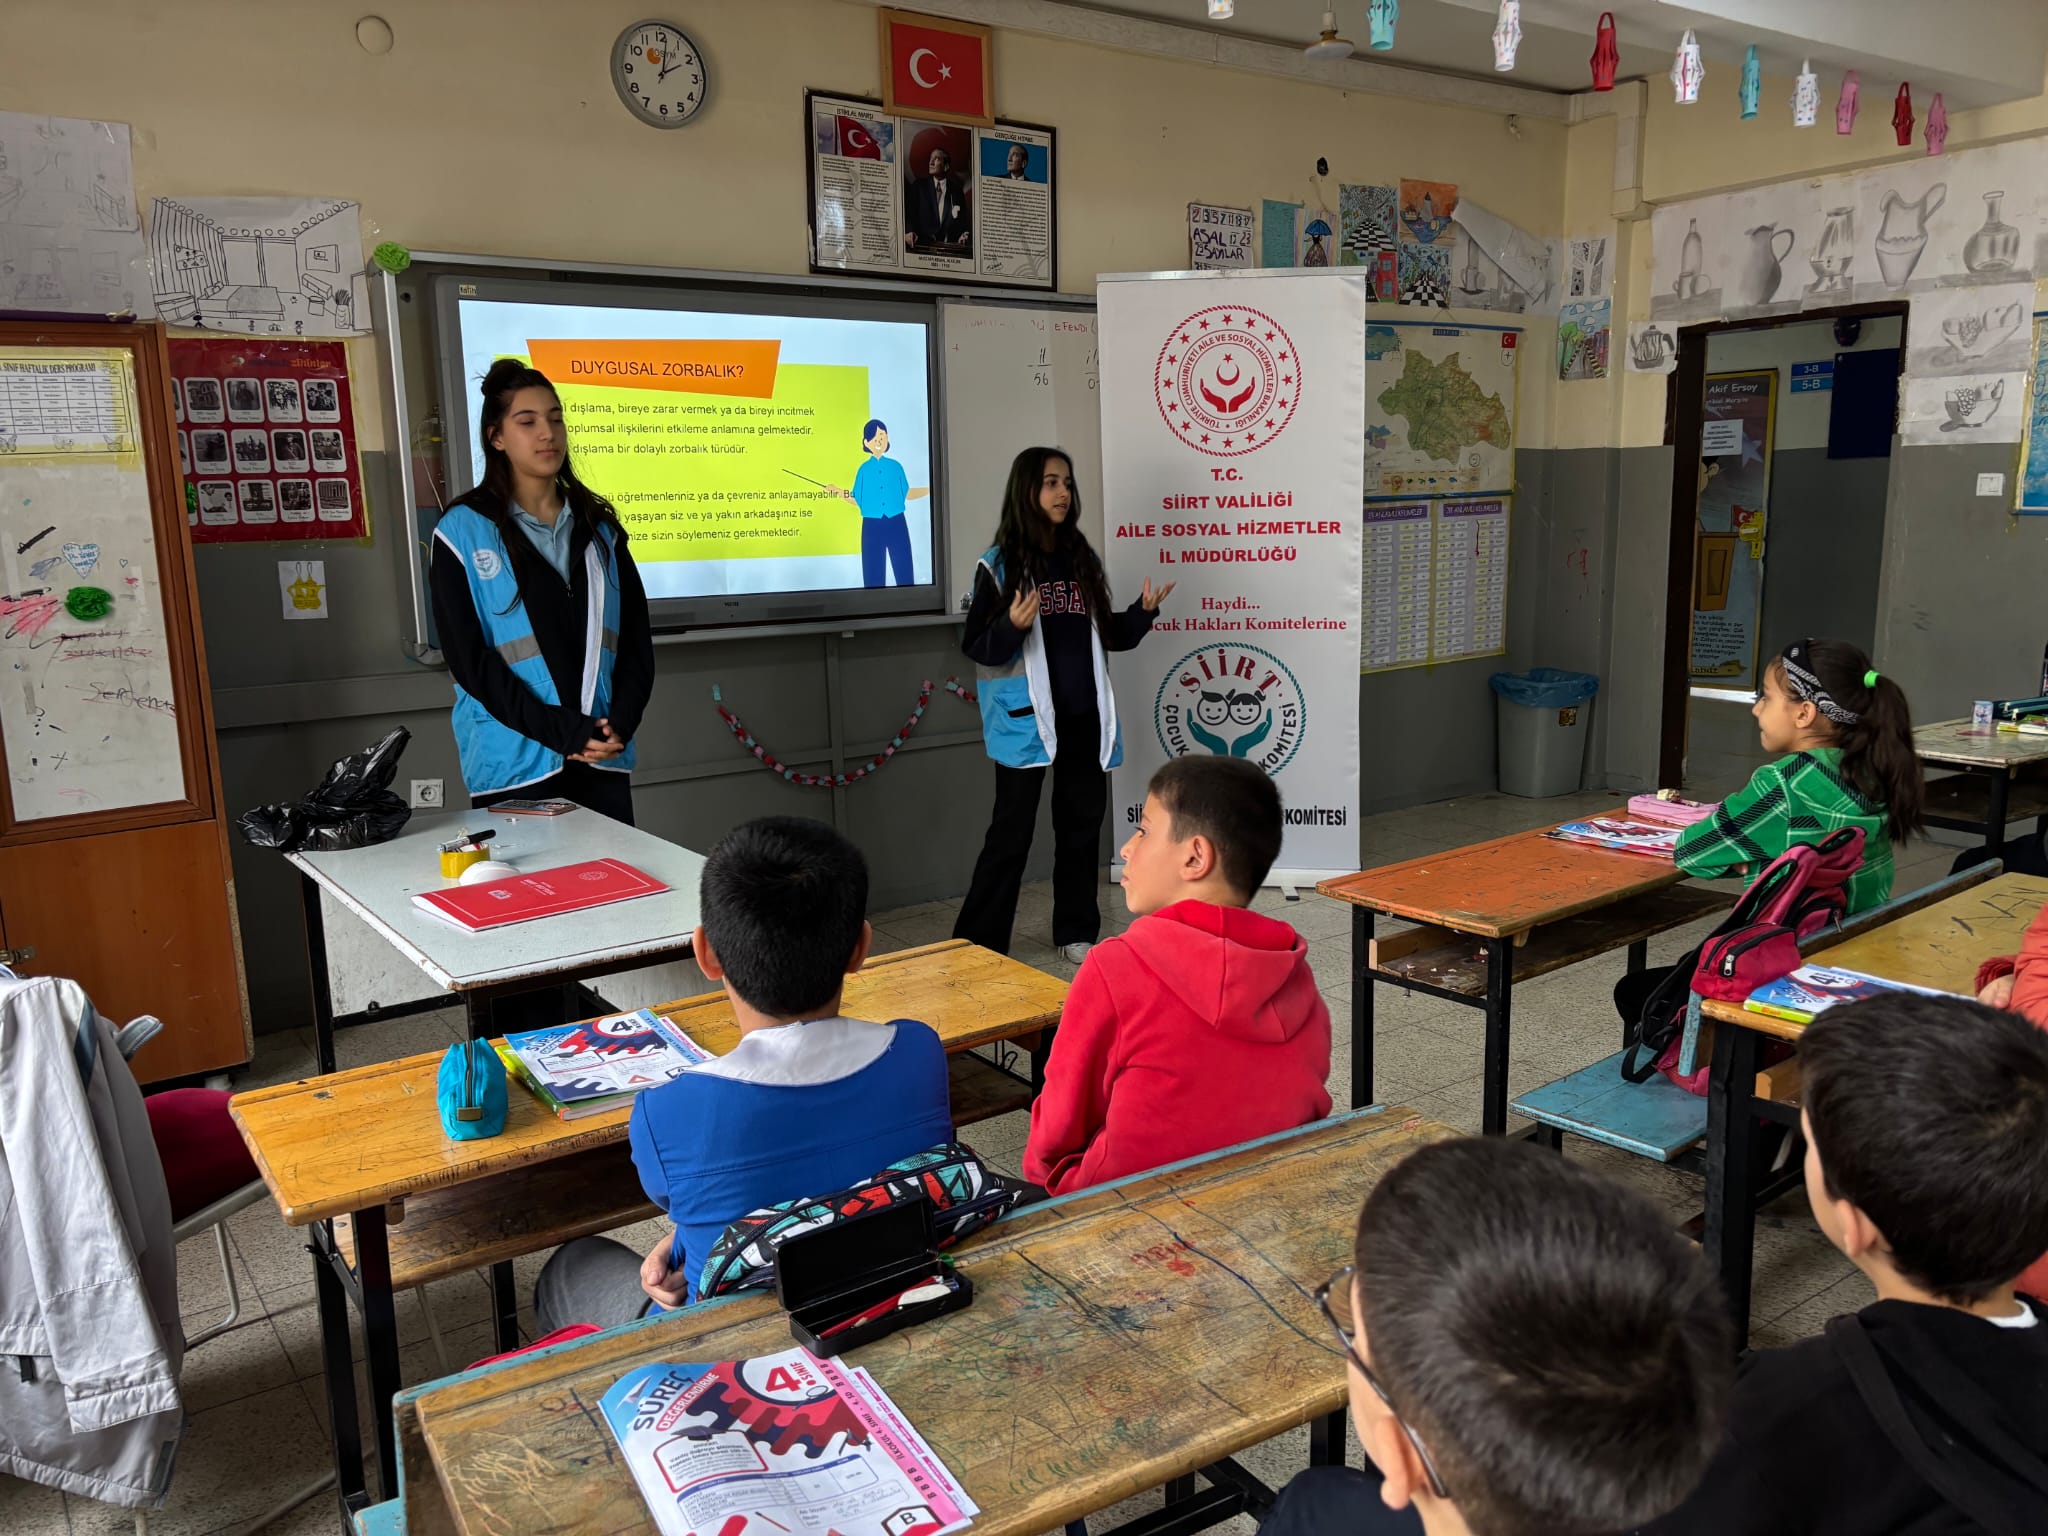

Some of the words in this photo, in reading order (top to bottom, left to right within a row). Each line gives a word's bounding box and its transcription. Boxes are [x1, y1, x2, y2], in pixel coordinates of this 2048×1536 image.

[641, 34, 648, 45] 11
[656, 31, 667, 43] 12
[630, 44, 642, 56] 10
[684, 54, 693, 65] 2
[624, 63, 633, 74] 9
[691, 74, 698, 84] 3
[630, 82, 639, 93] 8
[642, 97, 650, 108] 7
[687, 92, 695, 102] 4
[660, 104, 668, 115] 6
[677, 102, 685, 113] 5
[1193, 227, 1227, 247] ASAL
[1199, 337, 1215, 352] AİLE
[1215, 334, 1226, 343] VE
[1228, 333, 1256, 350] SOSYAL
[571, 360, 658, 376] DUYGUSAL
[662, 362, 744, 378] ZORBALIK?
[1256, 347, 1274, 394] HİZMETLER
[1804, 364, 1819, 374] 3-B
[1033, 373, 1049, 386] 56
[1182, 349, 1199, 406] CUMHURİYETİ
[1802, 379, 1821, 390] 5-B
[1708, 383, 1729, 394] Akif
[1731, 383, 1759, 393] Ersoy
[570, 403, 615, 415] dışlama,
[618, 403, 650, 416] bireye
[652, 405, 678, 414] zarar
[680, 404, 718, 415] vermek
[720, 406, 732, 417] ya
[734, 405, 747, 415] da
[749, 405, 775, 418] bireyi
[777, 406, 815, 416] incitmek
[1191, 406, 1220, 429] TÜRKİYE
[1235, 395, 1271, 428] BAKANLIĞI
[567, 423, 615, 435] oplumsal
[618, 424, 664, 435] ilişkilerini
[666, 424, 709, 434] etkileme
[711, 424, 755, 434] anlamına
[757, 425, 814, 436] gelmektedir.
[573, 443, 614, 456] dışlama
[617, 443, 631, 453] bir
[633, 443, 666, 456] dolaylı
[669, 443, 709, 454] zorbalık
[711, 444, 748, 454] türüdür.
[1210, 467, 1244, 482] T.C.
[617, 491, 695, 504] öğretmenleriniz
[697, 492, 710, 504] ya
[711, 491, 724, 500] da
[726, 490, 767, 503] çevreniz
[1162, 493, 1210, 510] SİİRT
[1215, 490, 1293, 509] VALİLİĞİ
[624, 512, 667, 524] yaşayan
[669, 510, 684, 520] siz
[686, 512, 699, 520] ve
[701, 512, 713, 522] ya
[715, 509, 741, 521] yakın
[743, 509, 798, 521] arkadaşınız
[799, 508, 813, 518] ise
[651, 531, 674, 541] sizin
[676, 529, 731, 542] söylemeniz
[733, 528, 802, 540] gerekmektedir.
[1115, 522, 1156, 538] AİLE
[1161, 522, 1231, 537] SOSYAL
[1236, 519, 1342, 536] HİZMETLER
[1159, 548, 1176, 564] İL
[1180, 546, 1297, 564] MÜDÜRLÜĞÜ
[1201, 596, 1261, 614] Haydi...
[1150, 618, 1182, 632] cuk
[1184, 617, 1241, 631] Hakları
[1245, 617, 1347, 632] Komitelerine
[1179, 648, 1283, 694] SİİRT
[1162, 703, 1190, 757] ÇOCUK
[1257, 702, 1297, 772] KOMİTESİ
[1285, 804, 1347, 827] KOMİTESİ
[789, 1361, 814, 1381] SINIF
[633, 1370, 696, 1431] SÜREÇ
[879, 1434, 905, 1460] İLKOKUL
[899, 1512, 917, 1525] B
